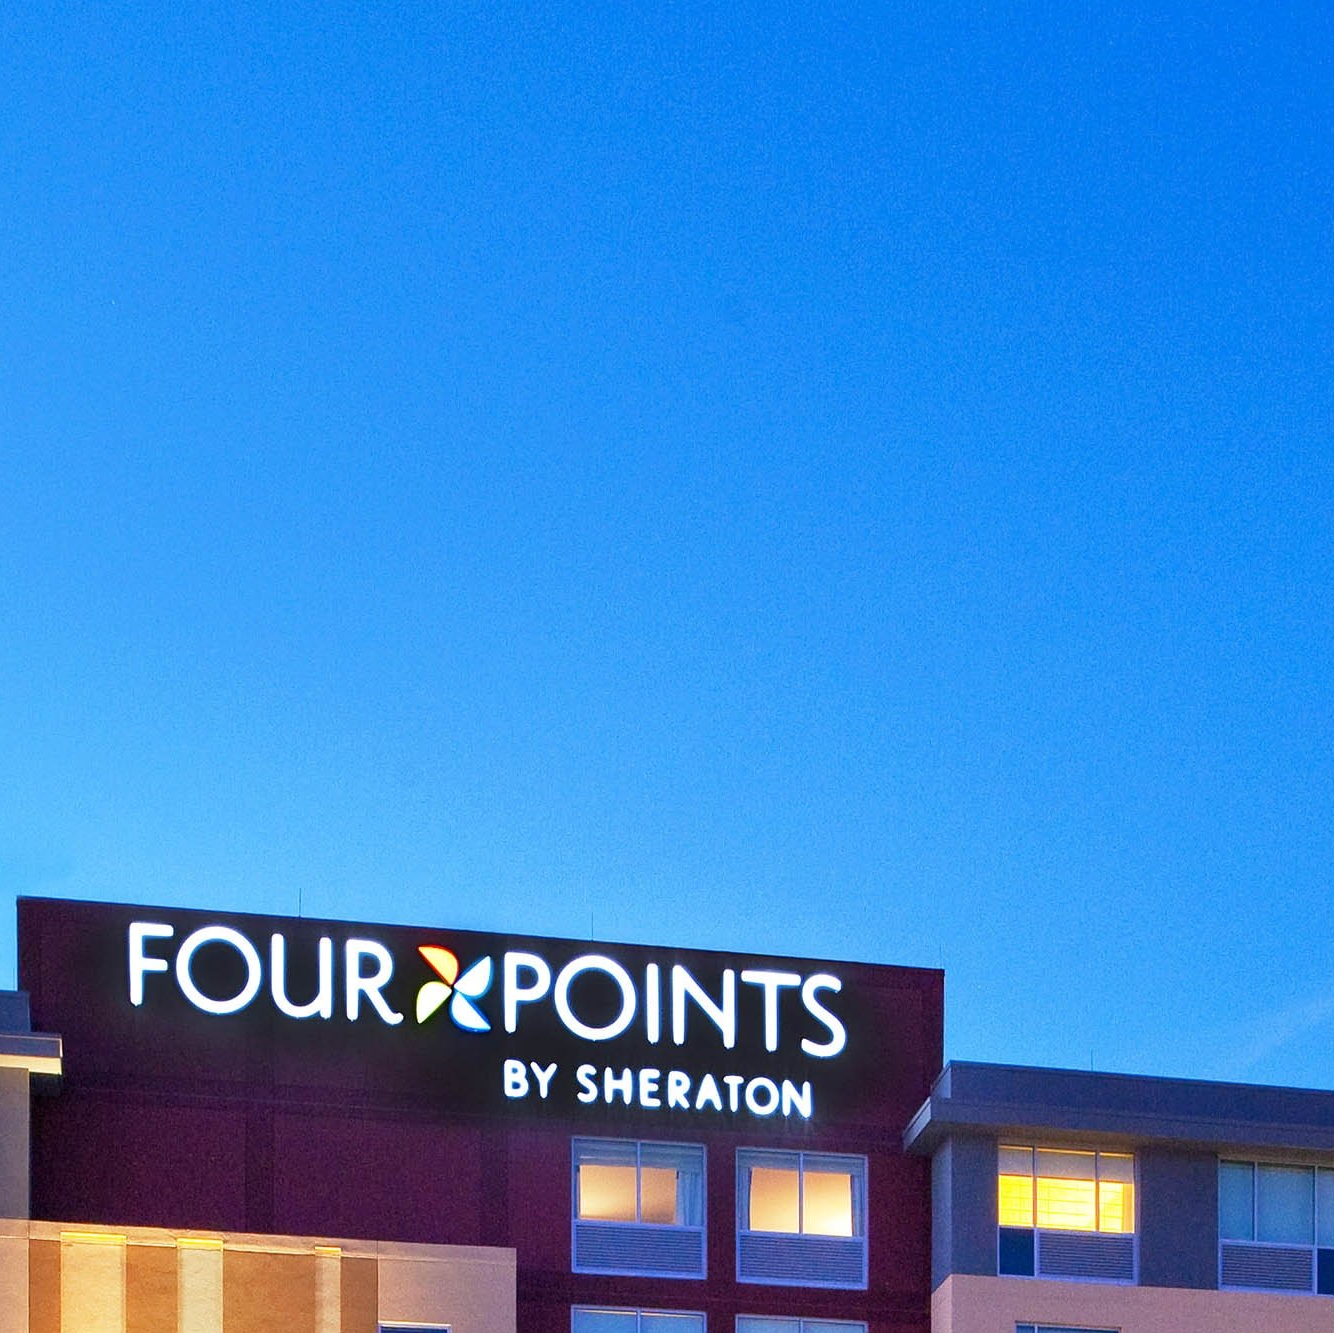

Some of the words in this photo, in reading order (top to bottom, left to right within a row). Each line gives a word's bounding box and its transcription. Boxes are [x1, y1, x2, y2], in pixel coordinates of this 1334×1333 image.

[128, 921, 404, 1025] FOUR
[504, 951, 847, 1058] POINTS
[503, 1059, 558, 1099] BY
[576, 1064, 813, 1119] SHERATON
